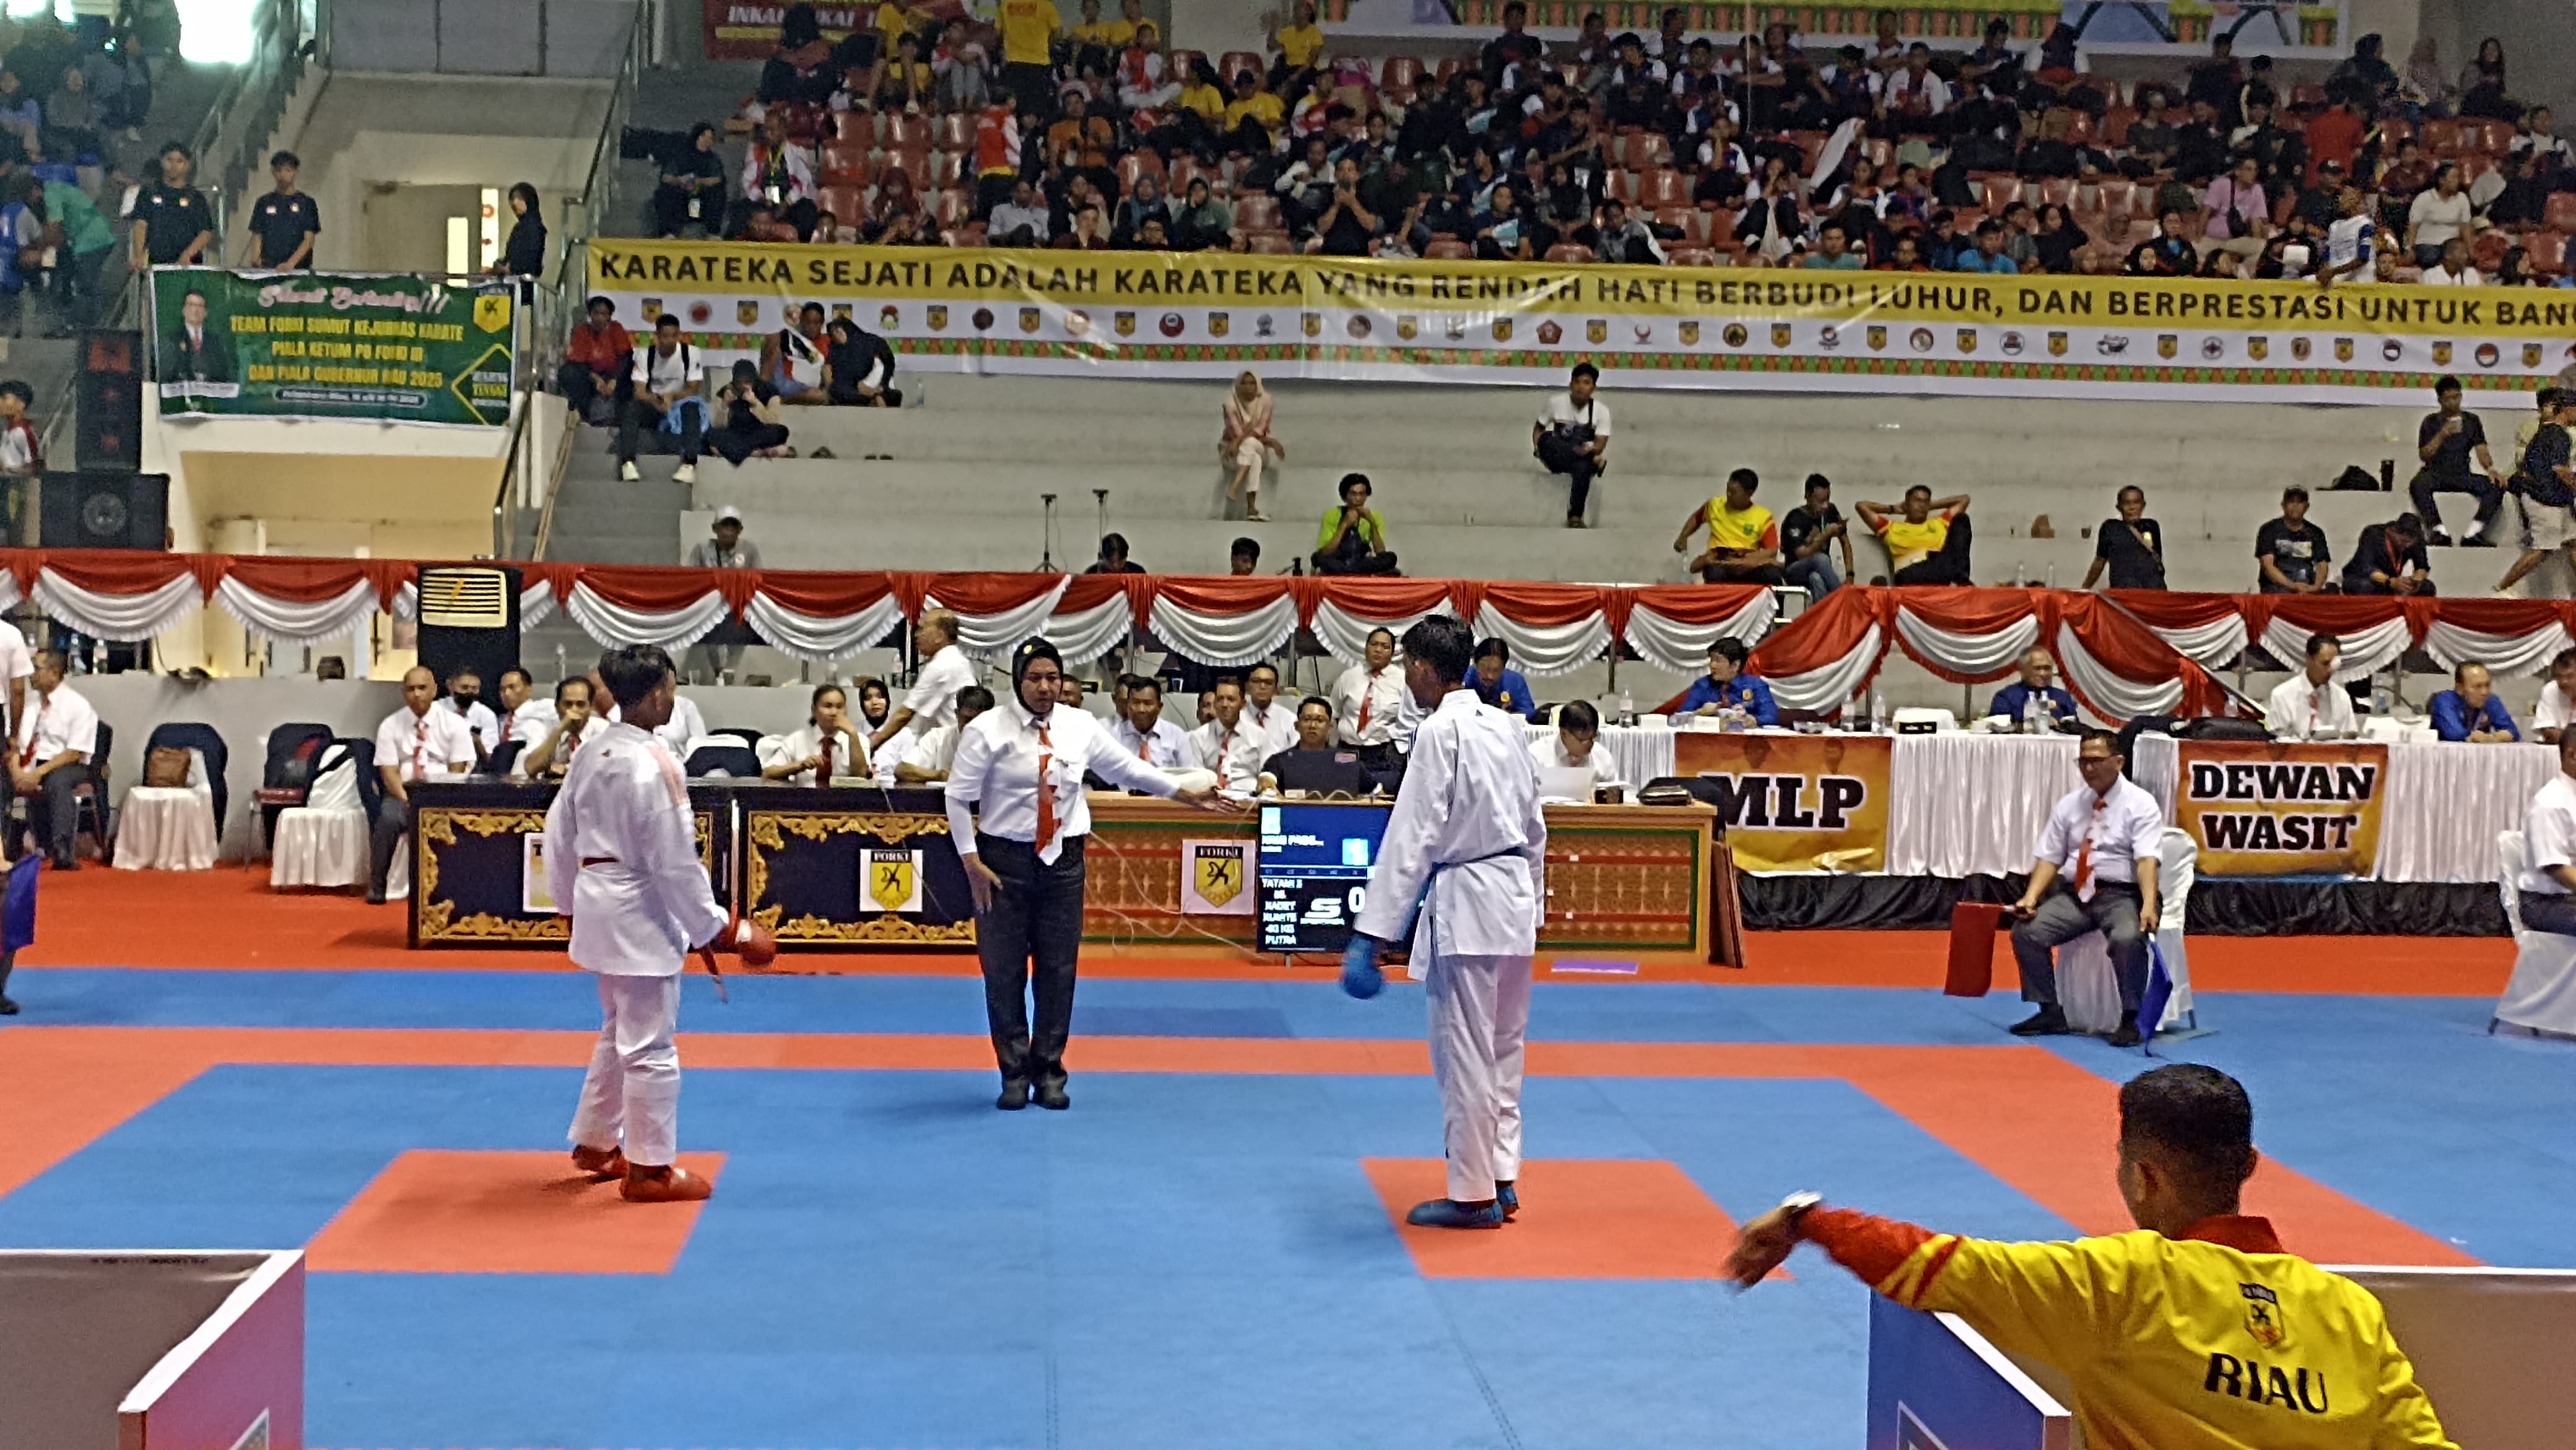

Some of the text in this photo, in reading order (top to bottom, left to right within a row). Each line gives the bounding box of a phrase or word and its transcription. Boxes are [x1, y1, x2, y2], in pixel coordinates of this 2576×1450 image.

[601, 254, 2576, 327] KARATEKA SEJATI ADALAH KARATEKA YANG RENDAH HATI BERBUDI LUHUR, DAN BERPRESTASI UNTUK BAN
[2190, 763, 2375, 801] DEWAN
[1699, 773, 1866, 830] MLP
[2201, 814, 2357, 851] WASIT
[874, 852, 909, 861] FORKI
[1200, 847, 1239, 857] FORKI
[2204, 1352, 2329, 1414] RIAU
